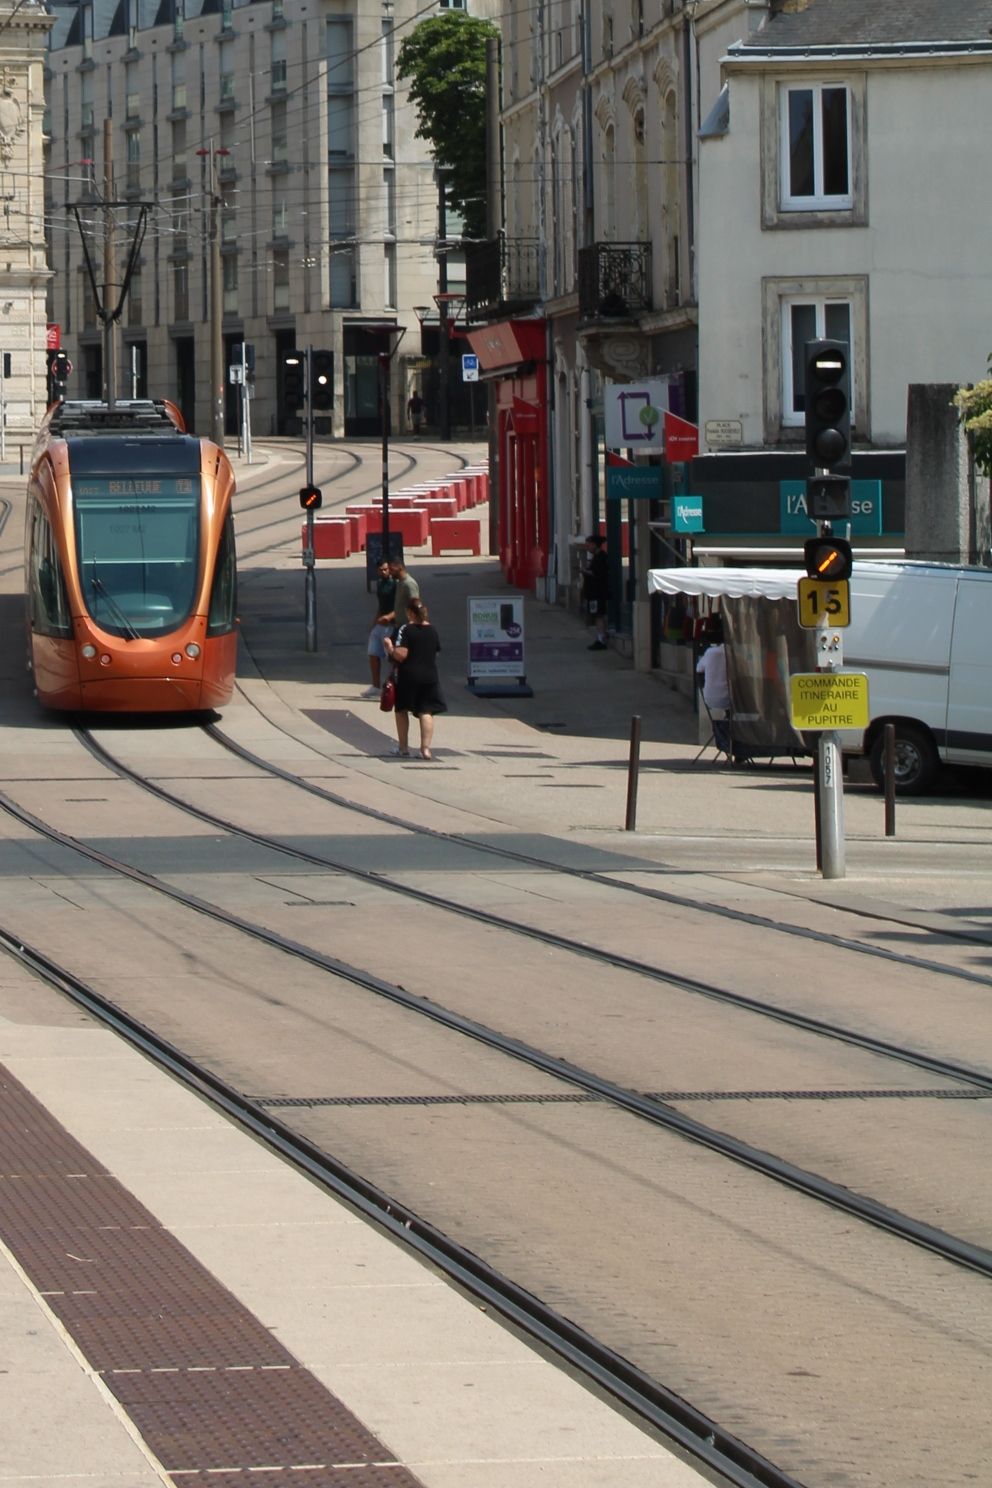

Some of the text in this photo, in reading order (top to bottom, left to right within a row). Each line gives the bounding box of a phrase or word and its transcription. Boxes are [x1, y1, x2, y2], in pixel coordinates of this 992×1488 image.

[611, 474, 659, 490] l'Adresse
[787, 494, 873, 515] l'Ase
[677, 505, 703, 524] l'Adresse
[807, 590, 842, 615] 15
[798, 678, 860, 688] COMMANDE
[800, 690, 859, 700] ITINERAIRE
[823, 703, 838, 712] AU
[807, 715, 853, 725] PUPITRE
